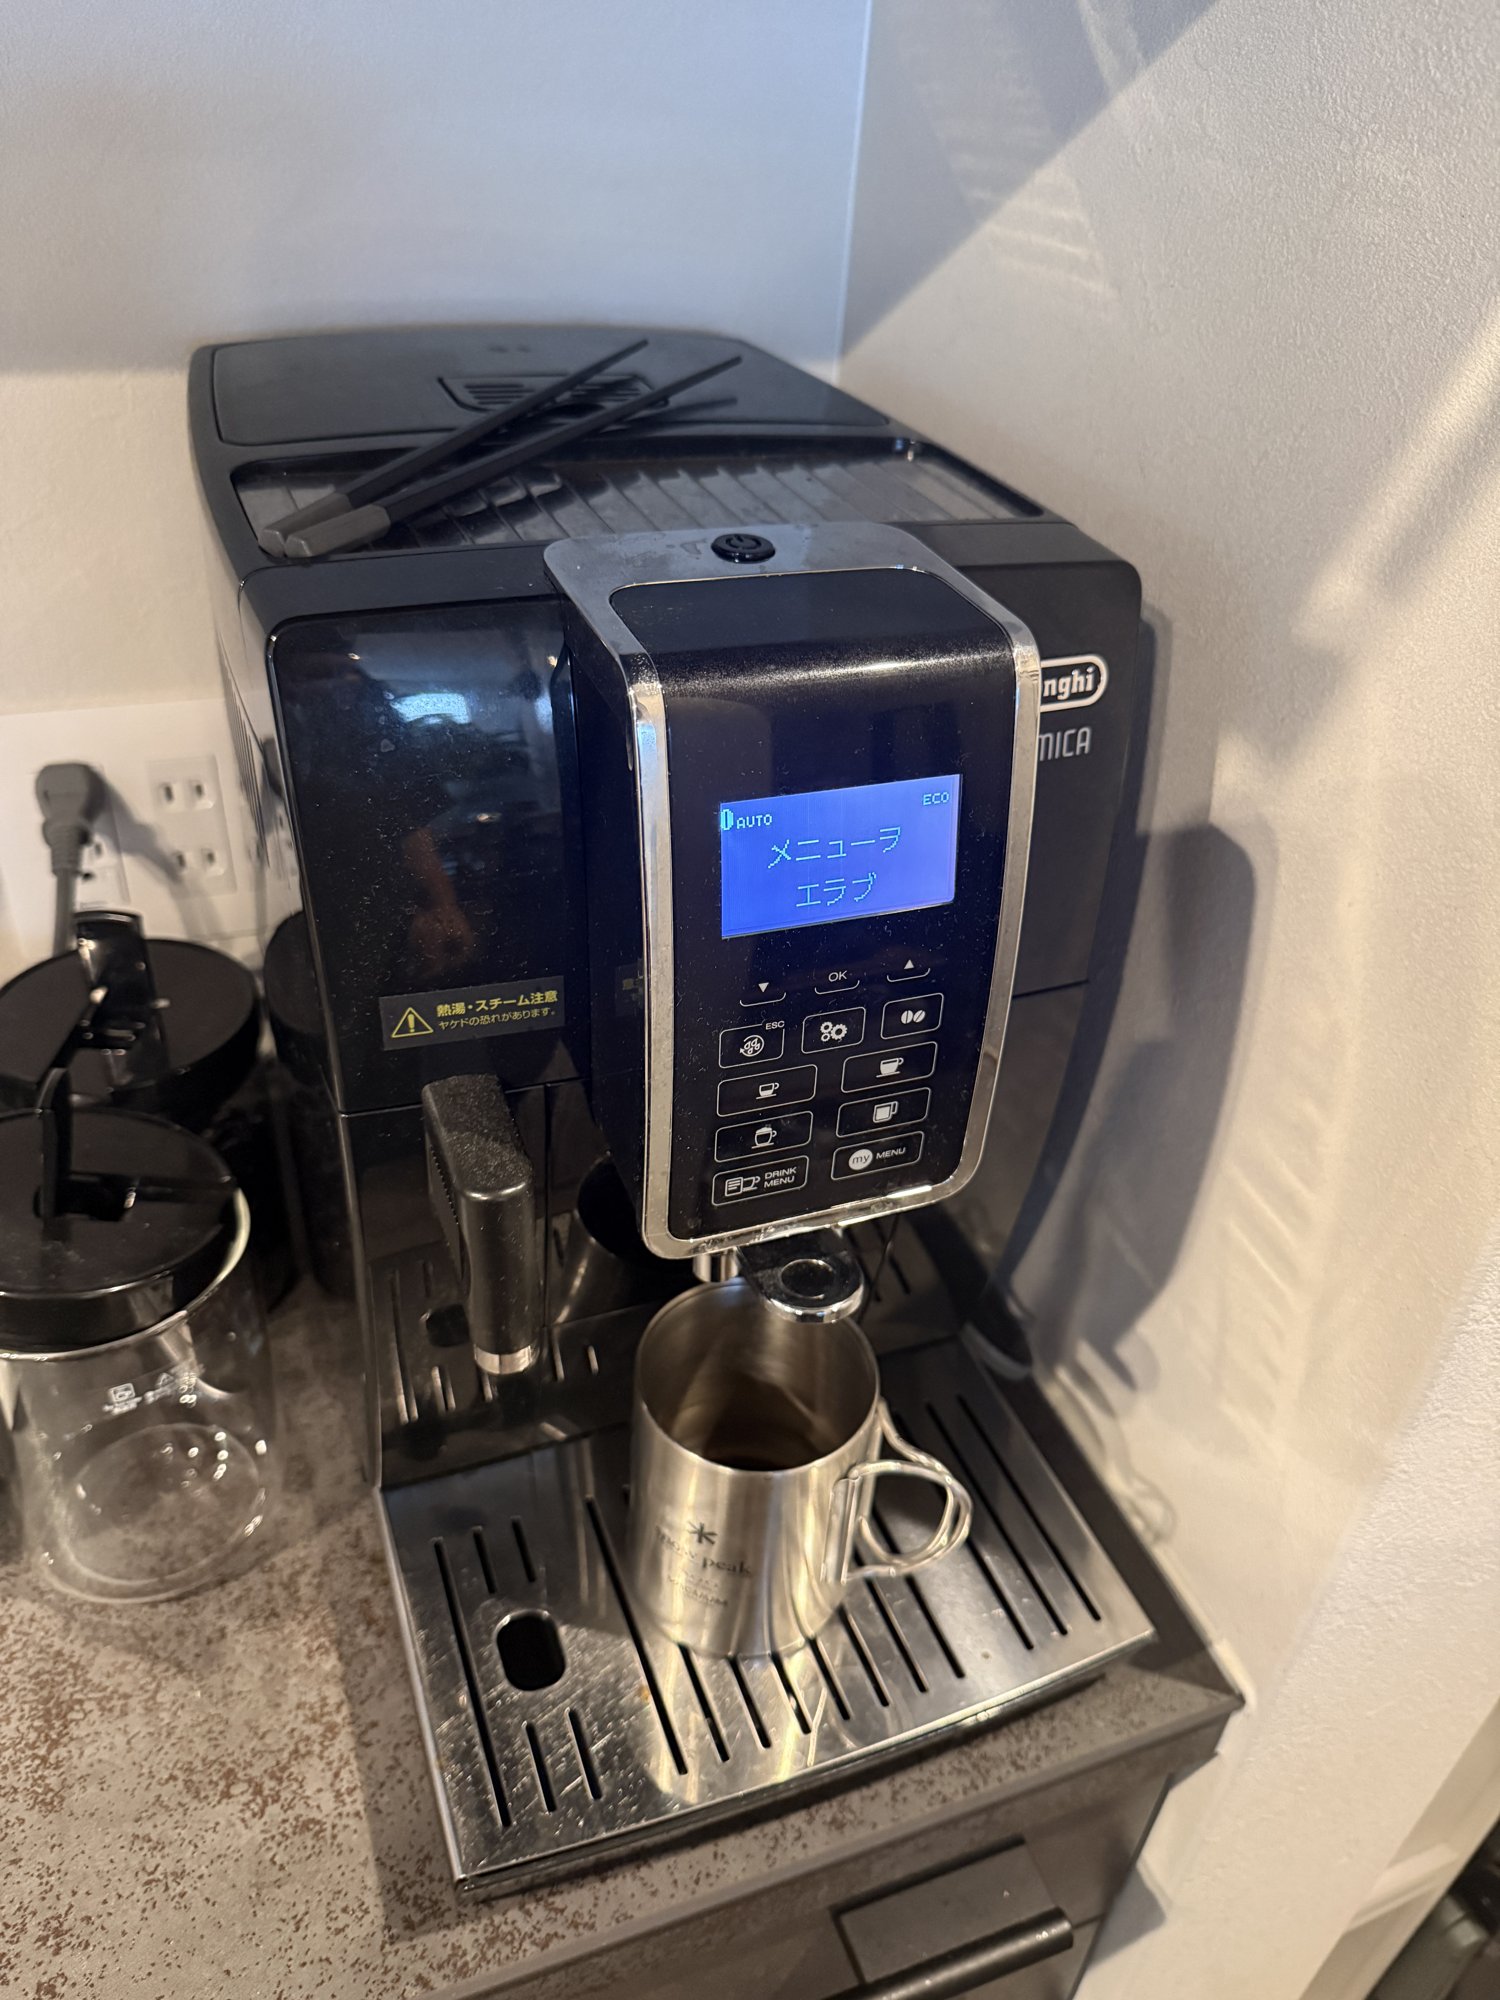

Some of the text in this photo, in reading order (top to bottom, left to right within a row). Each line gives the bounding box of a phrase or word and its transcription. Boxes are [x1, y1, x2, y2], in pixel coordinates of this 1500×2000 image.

[922, 791, 950, 806] ECO
[736, 813, 773, 829] AUTO
[767, 826, 901, 869] メニューヲ
[796, 872, 876, 906] エラブ
[828, 971, 848, 983] OK
[439, 1007, 556, 1030] ヤケドの恐れがあります。
[765, 1020, 785, 1030] ESC
[852, 1147, 906, 1164] my MENU
[764, 1166, 797, 1180] DRINK
[763, 1175, 795, 1188] MENU
